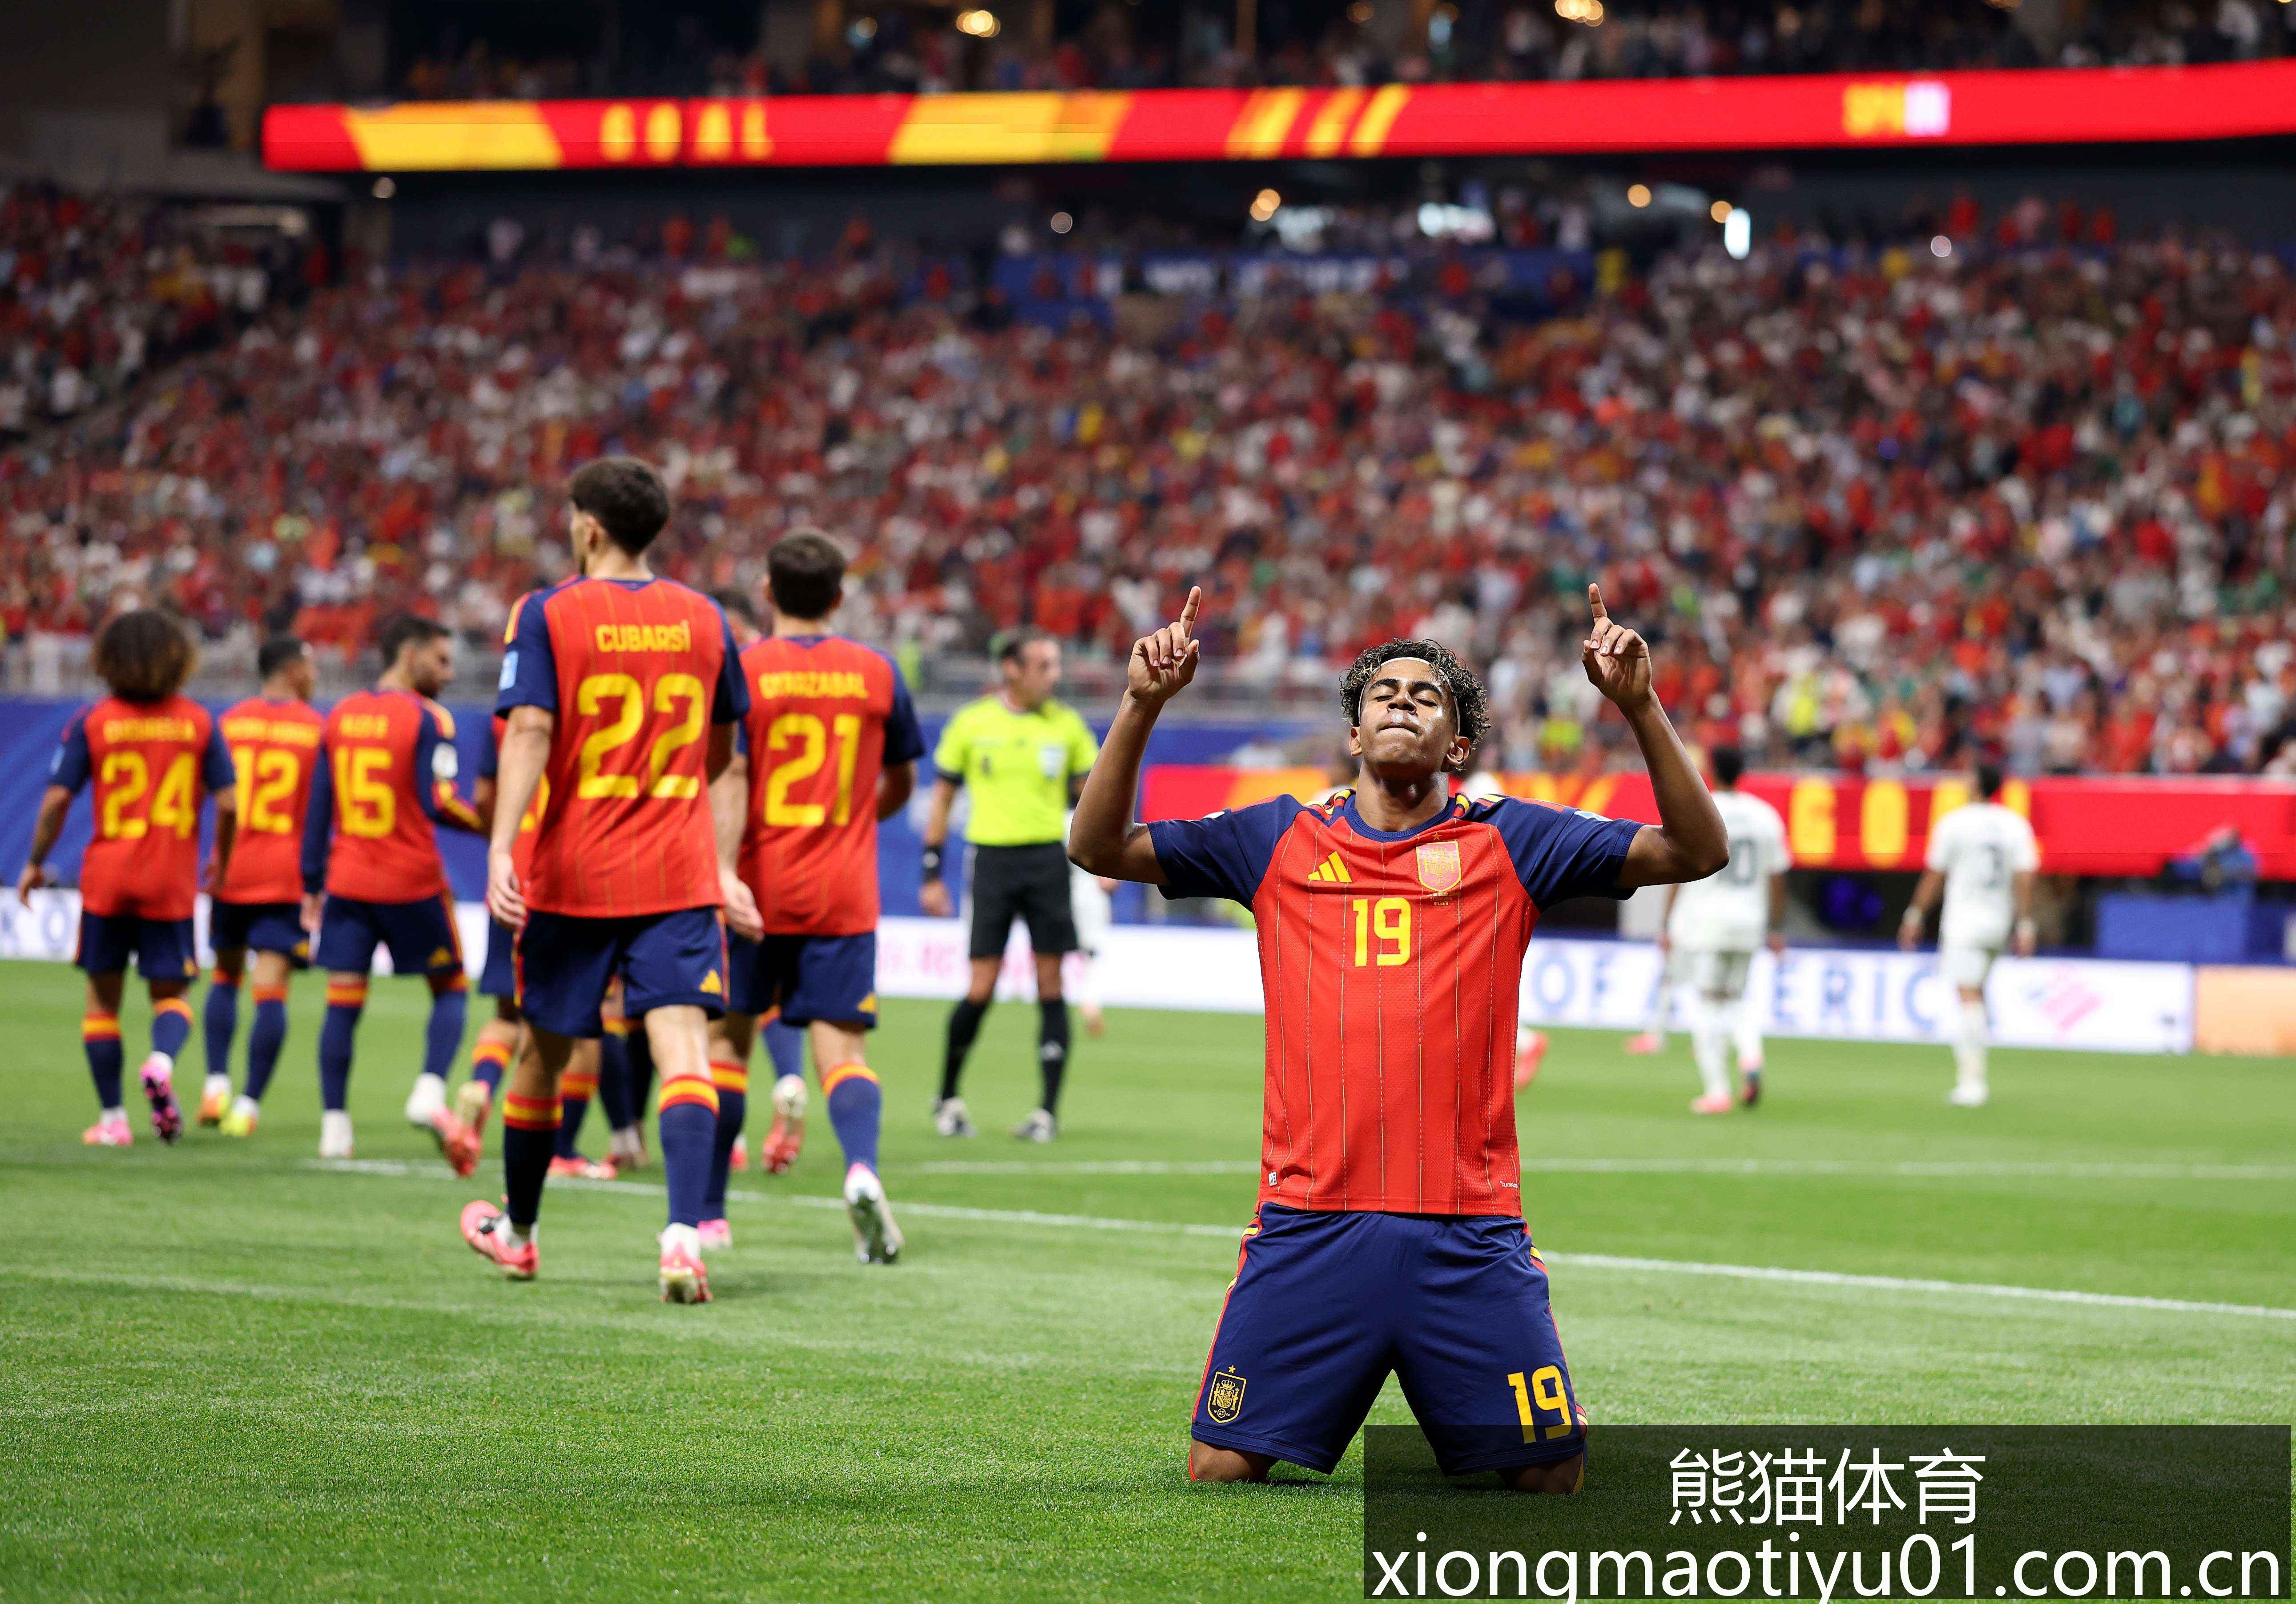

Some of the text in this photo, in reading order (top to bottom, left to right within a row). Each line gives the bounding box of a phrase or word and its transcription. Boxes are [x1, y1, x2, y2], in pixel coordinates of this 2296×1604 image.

[599, 103, 774, 160] GOAL
[578, 672, 705, 800] 22
[764, 713, 861, 827] 21
[101, 752, 196, 840] 24
[234, 744, 300, 835] 12
[335, 746, 395, 838] 15
[1352, 897, 1411, 967] 19
[1507, 1364, 1573, 1445] 19
